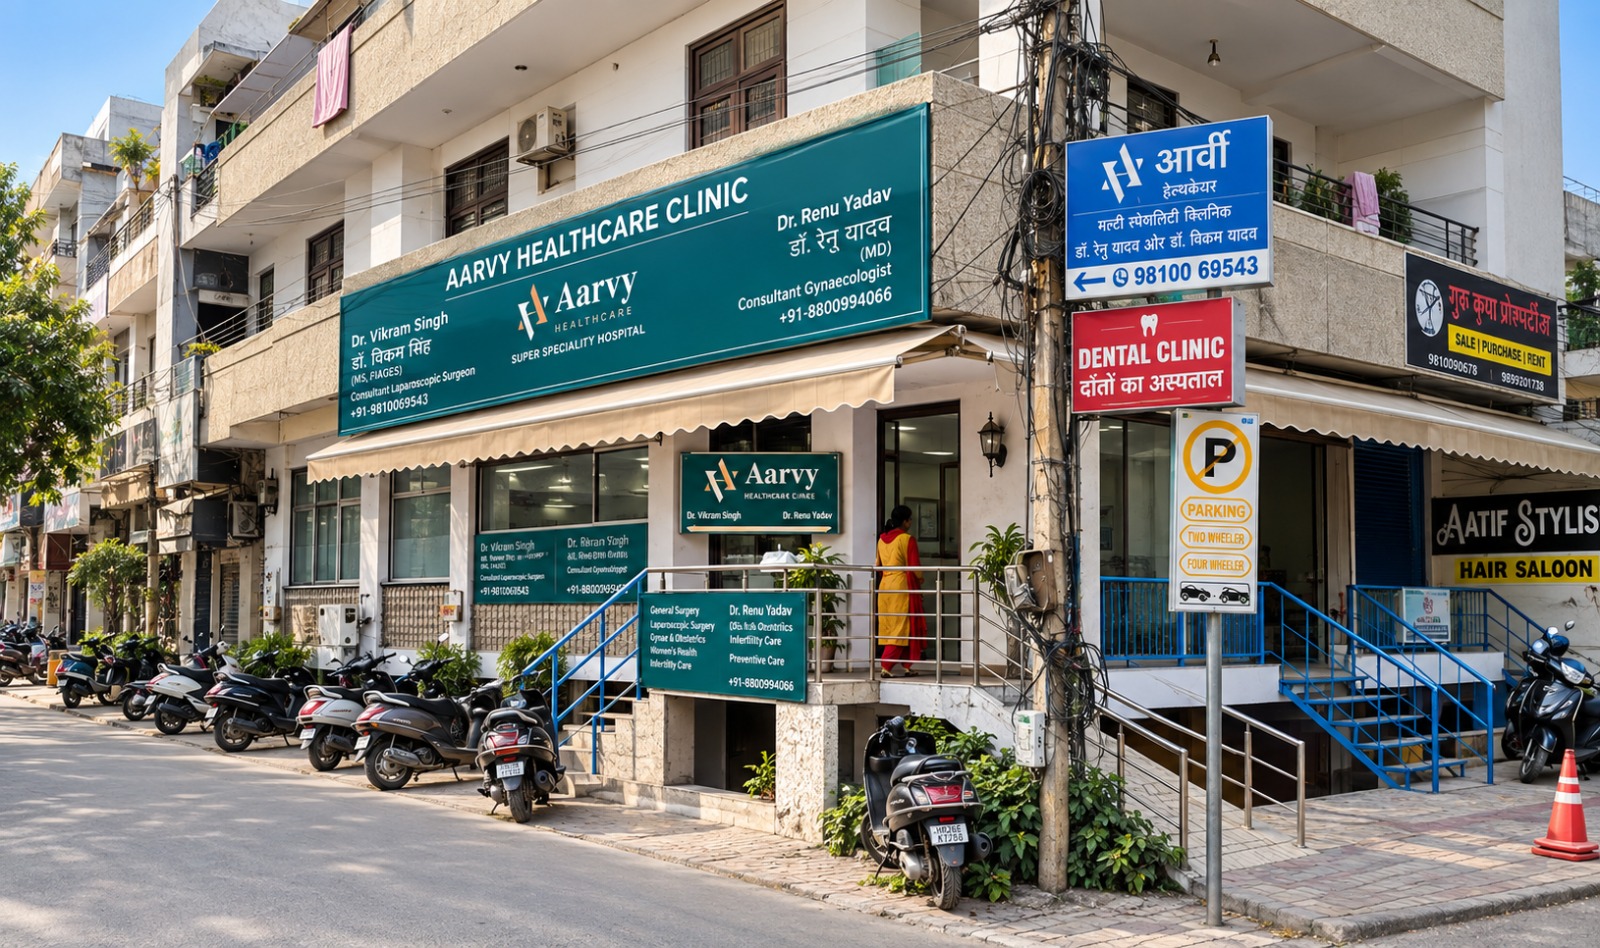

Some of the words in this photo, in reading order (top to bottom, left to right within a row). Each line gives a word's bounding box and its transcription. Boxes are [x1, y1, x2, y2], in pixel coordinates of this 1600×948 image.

[1155, 129, 1231, 174] आर्वी
[778, 214, 797, 232] Dr.
[801, 202, 839, 225] Renu
[842, 188, 892, 212] Yadav
[445, 251, 511, 292] AARVY
[517, 204, 658, 270] HEALTHCARE
[666, 176, 748, 223] CLINIC
[788, 232, 811, 257] डॉ.
[844, 215, 892, 241] यादव
[1112, 239, 1140, 254] यादव
[1228, 227, 1258, 241] यादव
[860, 241, 892, 262] (MD)
[1134, 262, 1192, 286] 98100
[1198, 256, 1258, 279] 69543
[554, 271, 638, 313] Aarvy
[738, 284, 801, 310] Consultant
[804, 262, 892, 296] Gynaecologist
[780, 286, 892, 323] +91-8800994066
[352, 335, 367, 348] Dr.
[370, 323, 410, 342] Vikram
[414, 311, 448, 331] Singh
[554, 306, 632, 332] HEALTHCARE
[351, 352, 367, 370] डॉ.
[408, 337, 432, 357] सिंह
[512, 349, 540, 364] SUPER
[542, 336, 595, 357] SPECIALITY
[597, 324, 646, 344] HOSPITAL
[1078, 344, 1151, 370] DENTAL
[1157, 336, 1225, 363] CLINIC
[1455, 333, 1476, 350] SALE
[1482, 341, 1522, 362] PURCHASE
[1528, 353, 1545, 368] RENT
[351, 375, 368, 386] (MS,
[369, 365, 403, 380] FIAGES)
[351, 385, 390, 402] Consultant
[391, 375, 441, 394] Laparoscopic
[442, 366, 476, 382] Surgeon
[1120, 376, 1144, 394] का
[351, 394, 428, 418] +91-9810069543
[745, 462, 819, 490] Aarvy
[722, 510, 742, 522] Singh
[1188, 504, 1246, 518] PARKING
[1436, 503, 1508, 546] AATIF
[1514, 499, 1600, 547] STYLIS
[1188, 531, 1206, 543] TWO
[1208, 532, 1244, 545] WHEELER
[1188, 559, 1207, 570] FOUR
[1460, 561, 1508, 579] HAIR
[1515, 560, 1592, 578] SALOON
[650, 606, 674, 615] General
[675, 606, 700, 618] Surgery
[729, 604, 740, 615] Dr.
[742, 605, 764, 616] Renu
[766, 604, 792, 616] Yadav
[691, 621, 715, 632] Surgery
[764, 636, 782, 646] Care
[677, 660, 692, 670] Care
[729, 653, 766, 664] Preventive
[767, 655, 784, 666] Care
[729, 677, 794, 691] +91-8800994066
